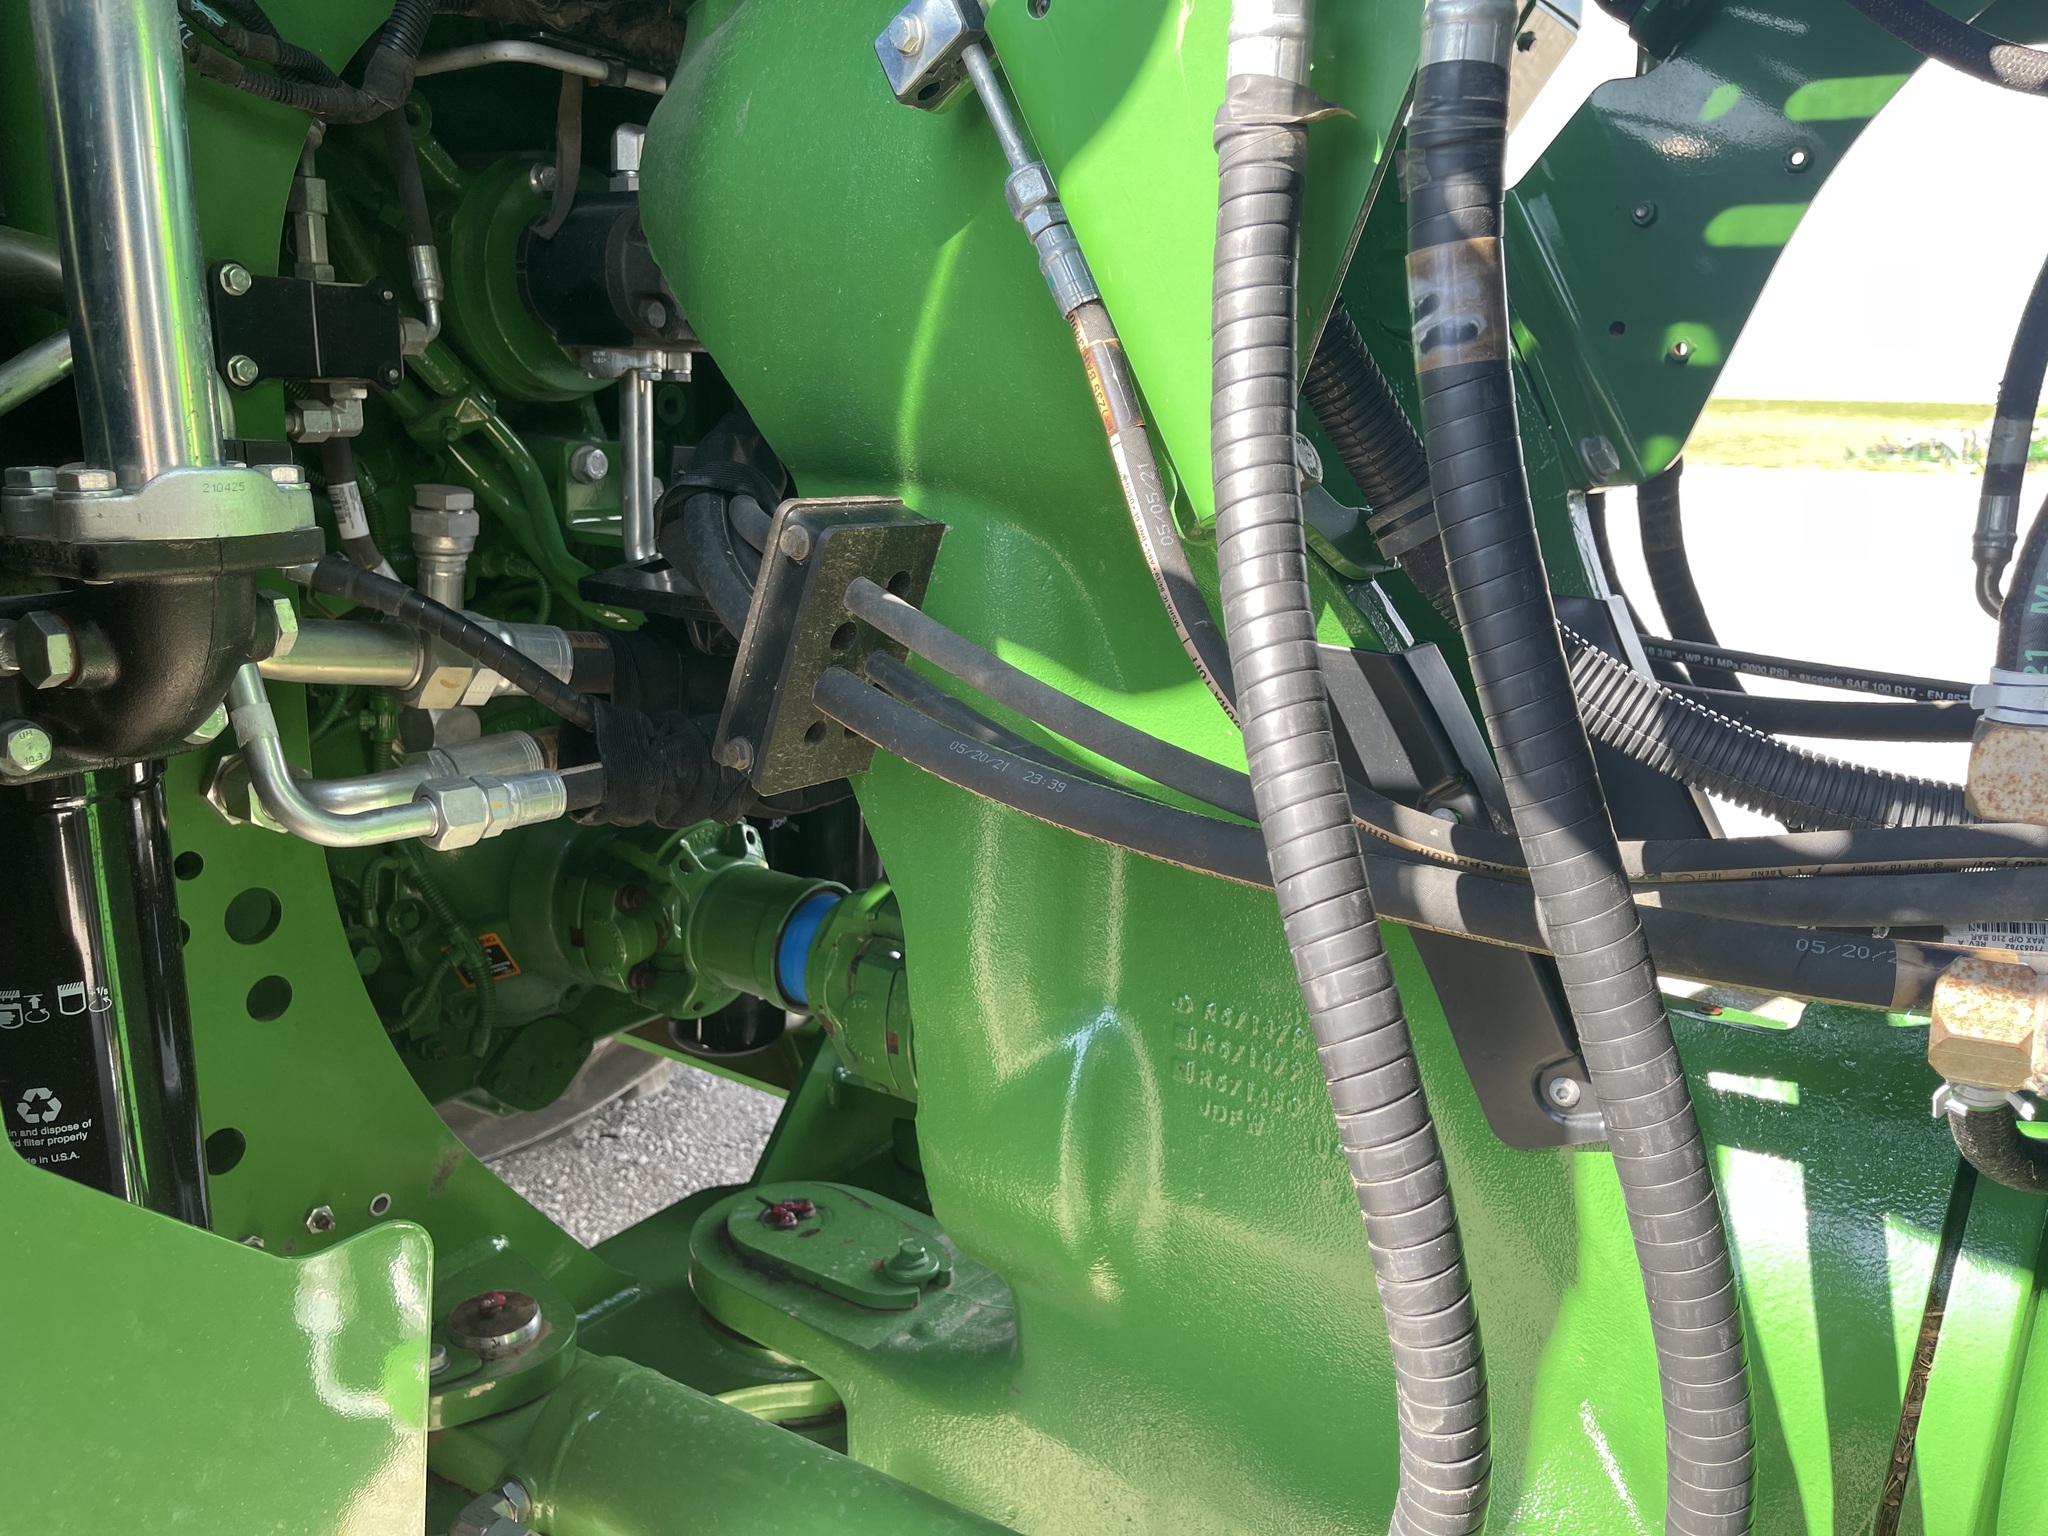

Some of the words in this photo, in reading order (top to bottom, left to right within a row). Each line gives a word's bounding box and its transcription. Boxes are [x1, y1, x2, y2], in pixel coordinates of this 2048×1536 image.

[202, 481, 245, 493] 210425
[1137, 463, 1174, 547] 05/05/21
[1685, 652, 1701, 664] WP
[1703, 655, 1714, 666] 21
[1717, 658, 1739, 670] MPa
[1799, 672, 1843, 687] exceeds
[1846, 678, 1869, 690] SAE
[1872, 682, 1891, 694] 100
[1895, 686, 1916, 698] R17
[1927, 690, 1944, 701] EN
[949, 740, 1010, 773] 05/20/21
[1022, 770, 1067, 793] 23:39
[1971, 933, 1989, 941] BAR
[1991, 934, 2005, 942] 210
[2008, 936, 2023, 944] O/P
[2025, 937, 2045, 945] MAX
[20, 1128, 38, 1136] and
[41, 1123, 79, 1135] dispose
[82, 1118, 92, 1128] of
[23, 1138, 45, 1147] filter
[47, 1132, 88, 1146] properly
[39, 1156, 48, 1164] in
[50, 1151, 80, 1163] U.S.A.
